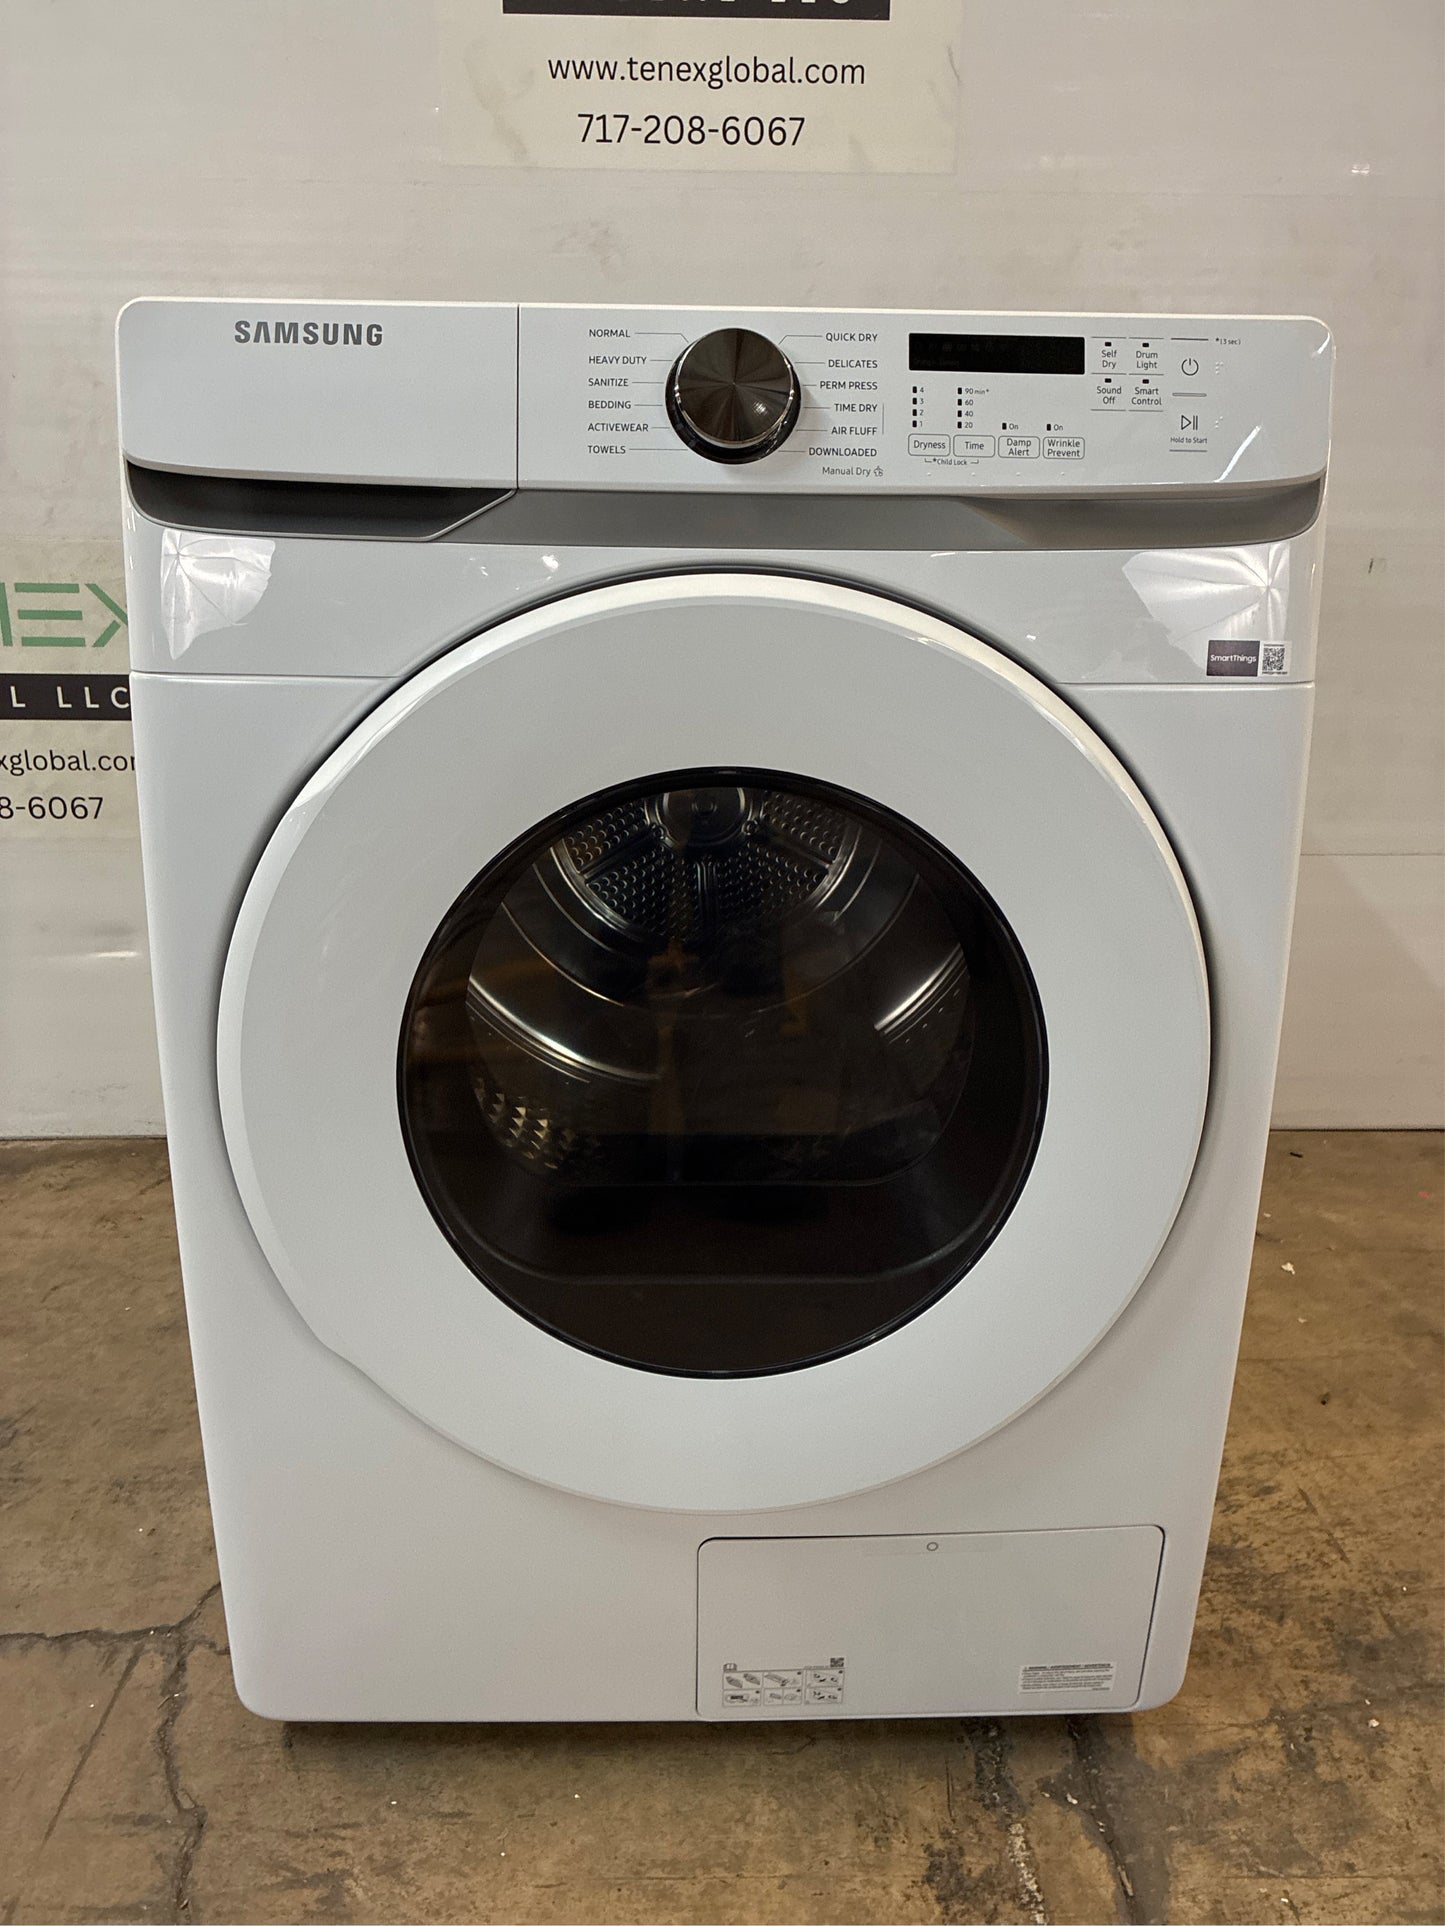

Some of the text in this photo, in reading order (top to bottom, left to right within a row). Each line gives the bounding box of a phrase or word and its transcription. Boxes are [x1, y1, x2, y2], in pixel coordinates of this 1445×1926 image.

[548, 56, 864, 89] www.tenexglobal.com
[578, 114, 805, 146] 717-208-6067
[235, 321, 382, 346] SAMSUNG
[589, 329, 630, 337] NORMAL
[826, 333, 877, 342] QUICK DRY
[589, 356, 646, 364] HEAVY DUTY
[829, 360, 877, 368] DELICATES
[1102, 360, 1116, 369] Dry
[1137, 361, 1157, 370] Light
[589, 378, 628, 386] SANITIZE
[820, 381, 877, 390] PERM PRESS
[1097, 386, 1121, 394] Sound
[1135, 387, 1158, 395] Smart
[1103, 396, 1115, 404] Off
[1132, 397, 1161, 405] Control
[589, 401, 631, 409] BEDDING
[834, 404, 877, 412] TIME DRY
[588, 423, 648, 431] ACTIVEWEAR
[831, 426, 877, 435] AIR FLUFF
[913, 440, 946, 450] Dryness
[964, 441, 984, 450] Time
[1007, 439, 1031, 447] Damp
[1047, 440, 1080, 448] Wrinkle
[588, 445, 625, 454] TOWELS
[809, 447, 877, 456] DOWNLOADED
[1047, 449, 1080, 457] Prevent
[822, 466, 871, 477] Manual Dry
[1210, 654, 1256, 664] SmartThings
[56, 686, 130, 709] LLC
[0, 749, 135, 776] xglobal.co
